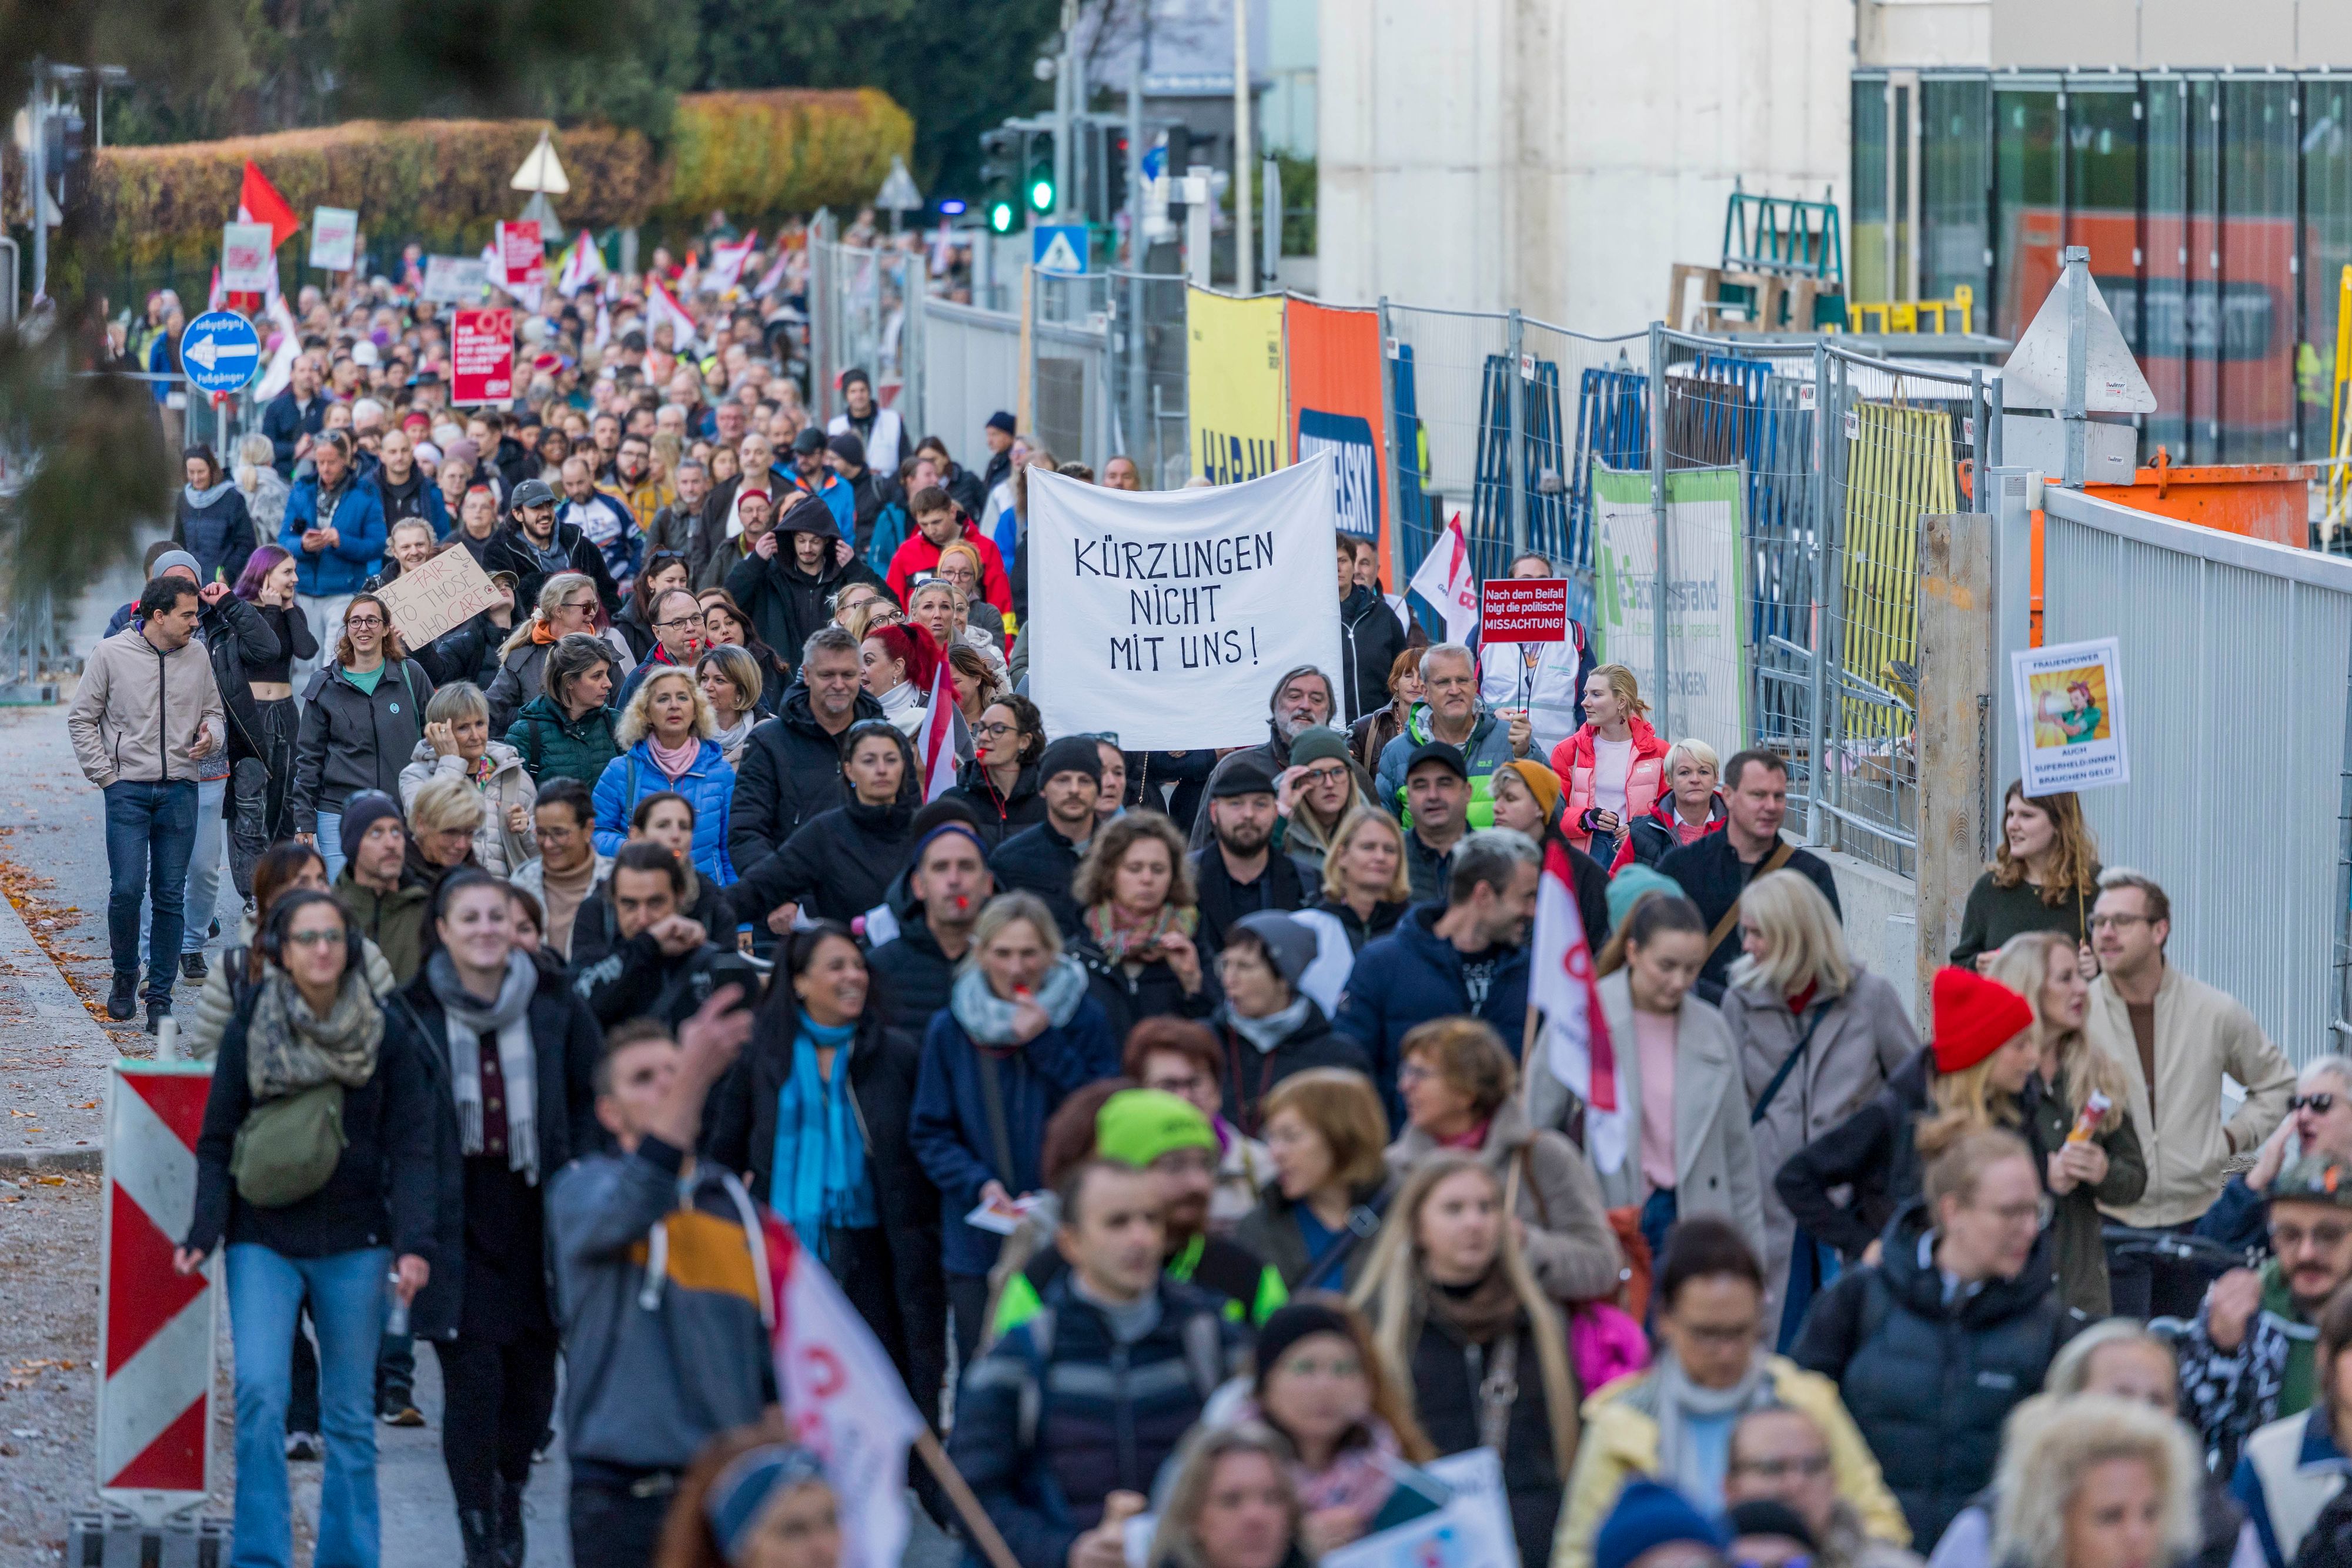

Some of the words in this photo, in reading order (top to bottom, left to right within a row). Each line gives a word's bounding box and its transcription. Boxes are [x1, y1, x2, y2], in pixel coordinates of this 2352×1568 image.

[1074, 531, 1273, 580] KÜRZUNGEN
[376, 583, 407, 607] BE
[406, 561, 452, 589] FAIR
[391, 604, 417, 626] TO
[417, 569, 477, 607] THOSE
[1486, 589, 1510, 600] Nach
[1512, 589, 1533, 599] dem
[1535, 588, 1564, 599] Beifall
[406, 614, 448, 646] WHO
[448, 588, 492, 623] CARE
[1131, 584, 1221, 625] NICHT
[1485, 602, 1505, 615] folgt
[1506, 601, 1520, 612] die
[1521, 601, 1563, 614] politische
[1485, 618, 1563, 630] MISSACHTUNG!
[1111, 634, 1164, 671] MIT
[2033, 653, 2099, 669] FRAUENPOWER
[2062, 746, 2087, 757] AUCH
[2039, 772, 2087, 784] BRAUCHEN
[2089, 767, 2114, 778] GELD!
